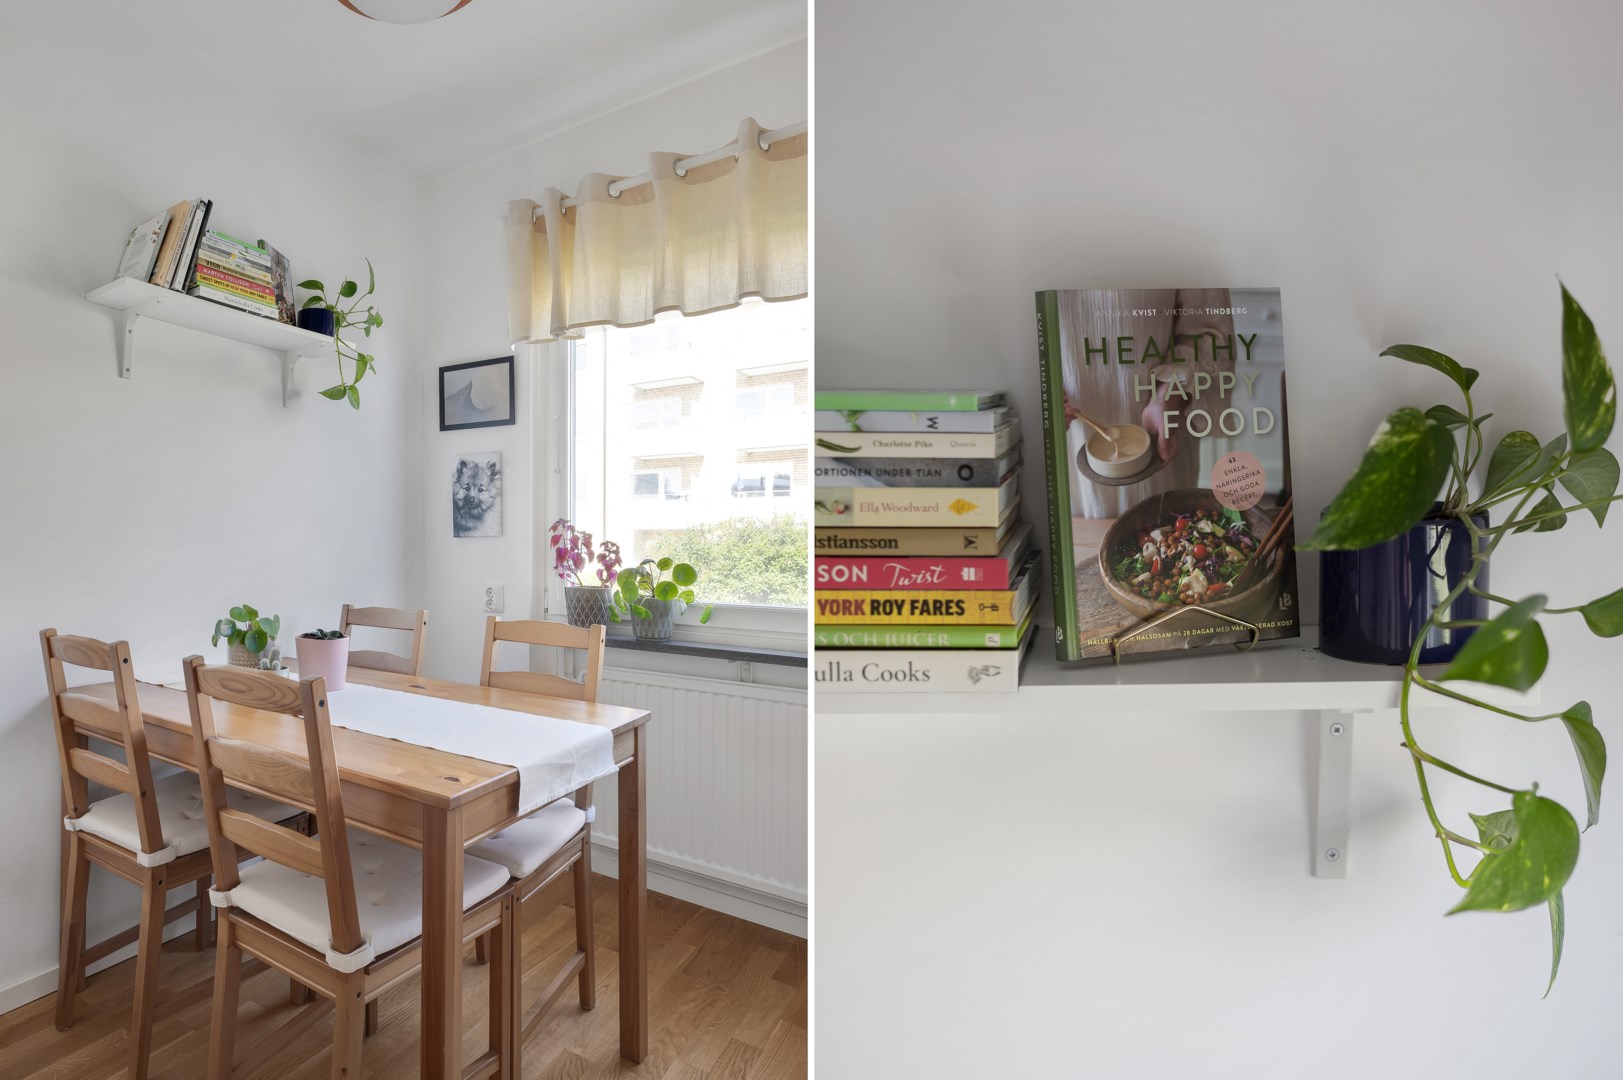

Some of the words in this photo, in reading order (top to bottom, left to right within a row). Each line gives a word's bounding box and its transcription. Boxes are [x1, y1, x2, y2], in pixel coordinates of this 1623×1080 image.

[203, 268, 224, 278] MARTHA
[225, 275, 249, 287] COLLISON
[257, 291, 267, 300] FARES
[1164, 308, 1202, 316] VIKTORIA
[1084, 333, 1258, 366] HEALTHY
[1040, 360, 1049, 429] TINDBERG
[1134, 371, 1260, 402] HAPPY
[1163, 407, 1275, 439] FOOD
[873, 440, 912, 448] Charlotte
[915, 440, 933, 448] Pike
[815, 468, 872, 476] ORTIONEN
[876, 468, 912, 477] UNDER
[916, 468, 942, 477] TIAN
[1046, 440, 1054, 500] HEALTHY
[1224, 488, 1239, 498] OCH
[1240, 481, 1260, 492] GODA
[860, 502, 879, 513] Ella
[882, 502, 939, 513] Woodward
[1049, 506, 1057, 550] HAPPY
[817, 565, 868, 582] SON
[882, 563, 948, 588] Twist
[818, 599, 866, 616] YORK
[870, 599, 905, 616] ROY
[910, 599, 966, 616] FARES
[834, 632, 878, 646] OCH
[886, 632, 950, 646] JUICER
[862, 661, 931, 682] Cooks
